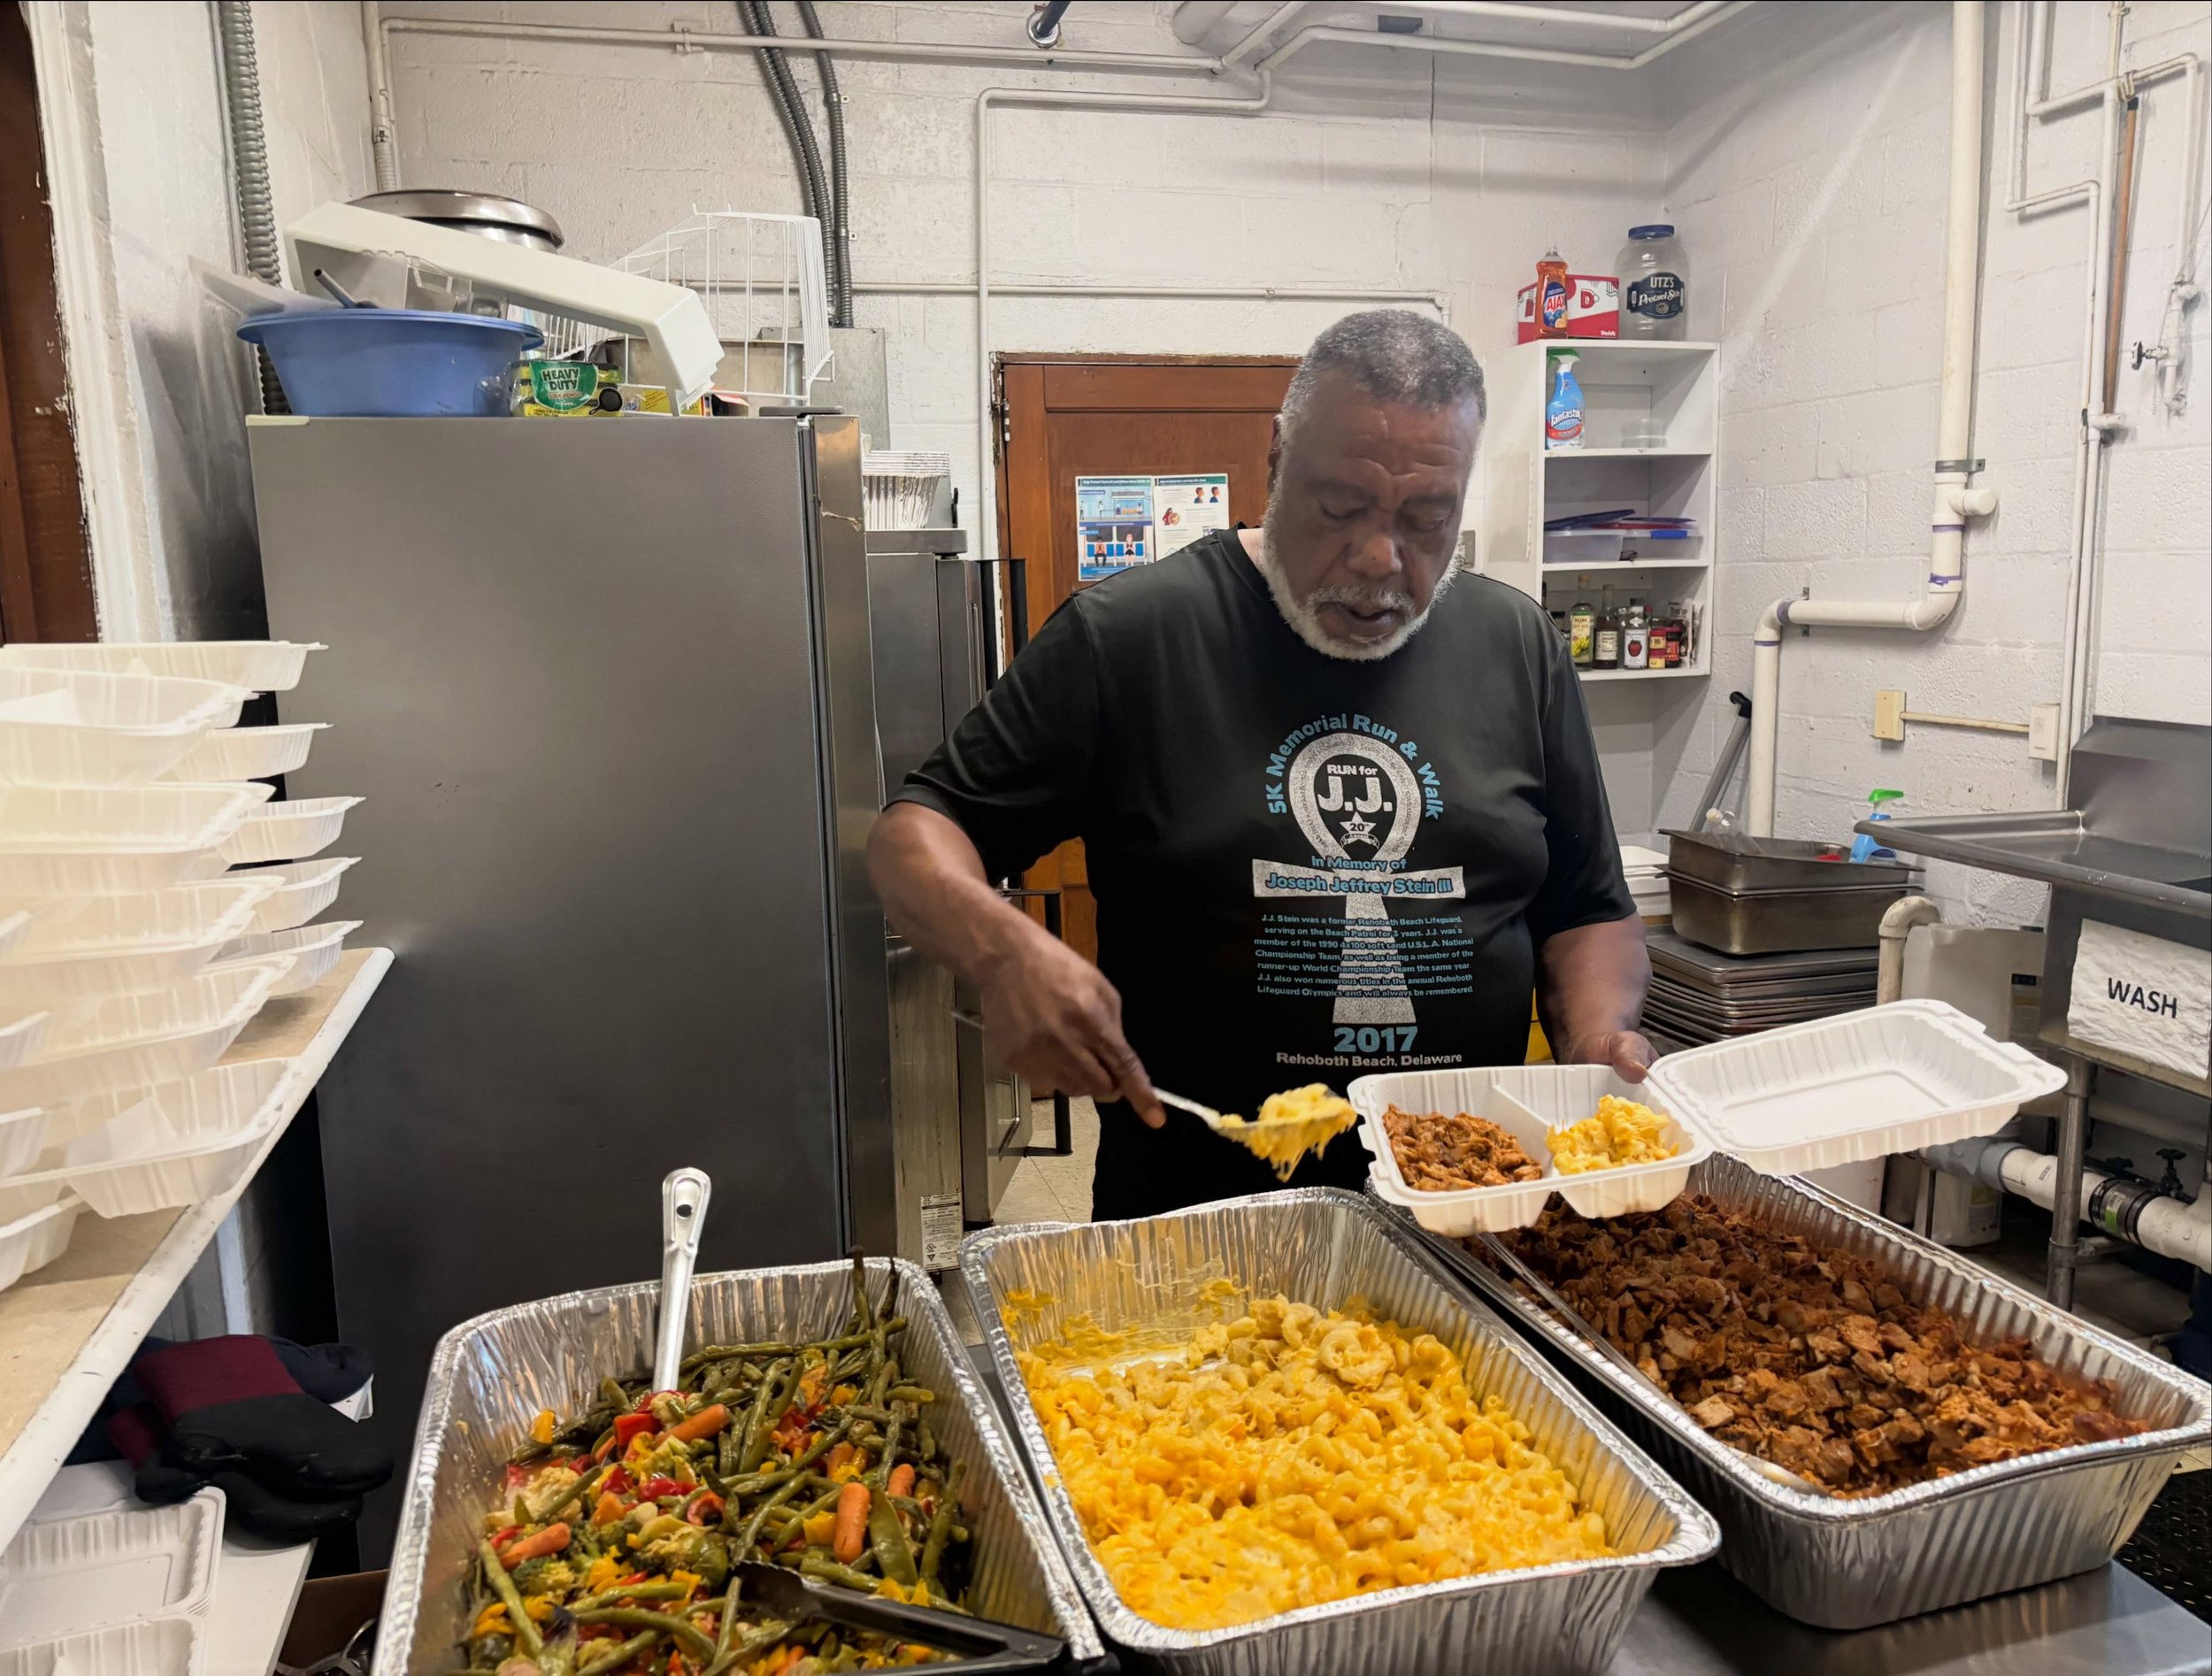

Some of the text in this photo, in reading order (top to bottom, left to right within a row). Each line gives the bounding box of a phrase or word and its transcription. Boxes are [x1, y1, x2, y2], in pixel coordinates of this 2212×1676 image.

[1638, 292, 1667, 306] Pretzel
[541, 368, 580, 381] HEAVY
[549, 379, 578, 390] DUTY
[1353, 713, 1398, 743] Run
[1266, 713, 1347, 777] Memorial
[1400, 741, 1418, 761] &
[1327, 764, 1379, 775] RUN for
[1266, 782, 1287, 814] 5K
[1317, 775, 1394, 813] J.J.
[1417, 762, 1444, 820] Walk
[1311, 855, 1407, 872] In Memory of
[1267, 873, 1453, 895] Joseph Jeffrey Stein III
[1328, 917, 1356, 926] former
[1358, 917, 1398, 926] Rehoboth
[1351, 929, 1377, 938] Patrol
[1379, 929, 1391, 938] for
[1302, 939, 1317, 948] the
[1318, 940, 1338, 949] 1990
[1442, 938, 1473, 947] National
[1255, 949, 1316, 961] Championship
[1386, 953, 1409, 962] being
[1330, 965, 1391, 974] Championship
[1273, 974, 1292, 983] also
[1407, 976, 1435, 985] annual
[1436, 973, 1473, 983] Rehoboth
[1256, 985, 1301, 996] Lifeguard
[1302, 988, 1342, 997] Olympics
[1381, 989, 1412, 998] always
[2108, 977, 2177, 1019] WASH
[1333, 1026, 1417, 1052] 2017
[1276, 1052, 1463, 1067] Rehoboth Beach, Delaware
